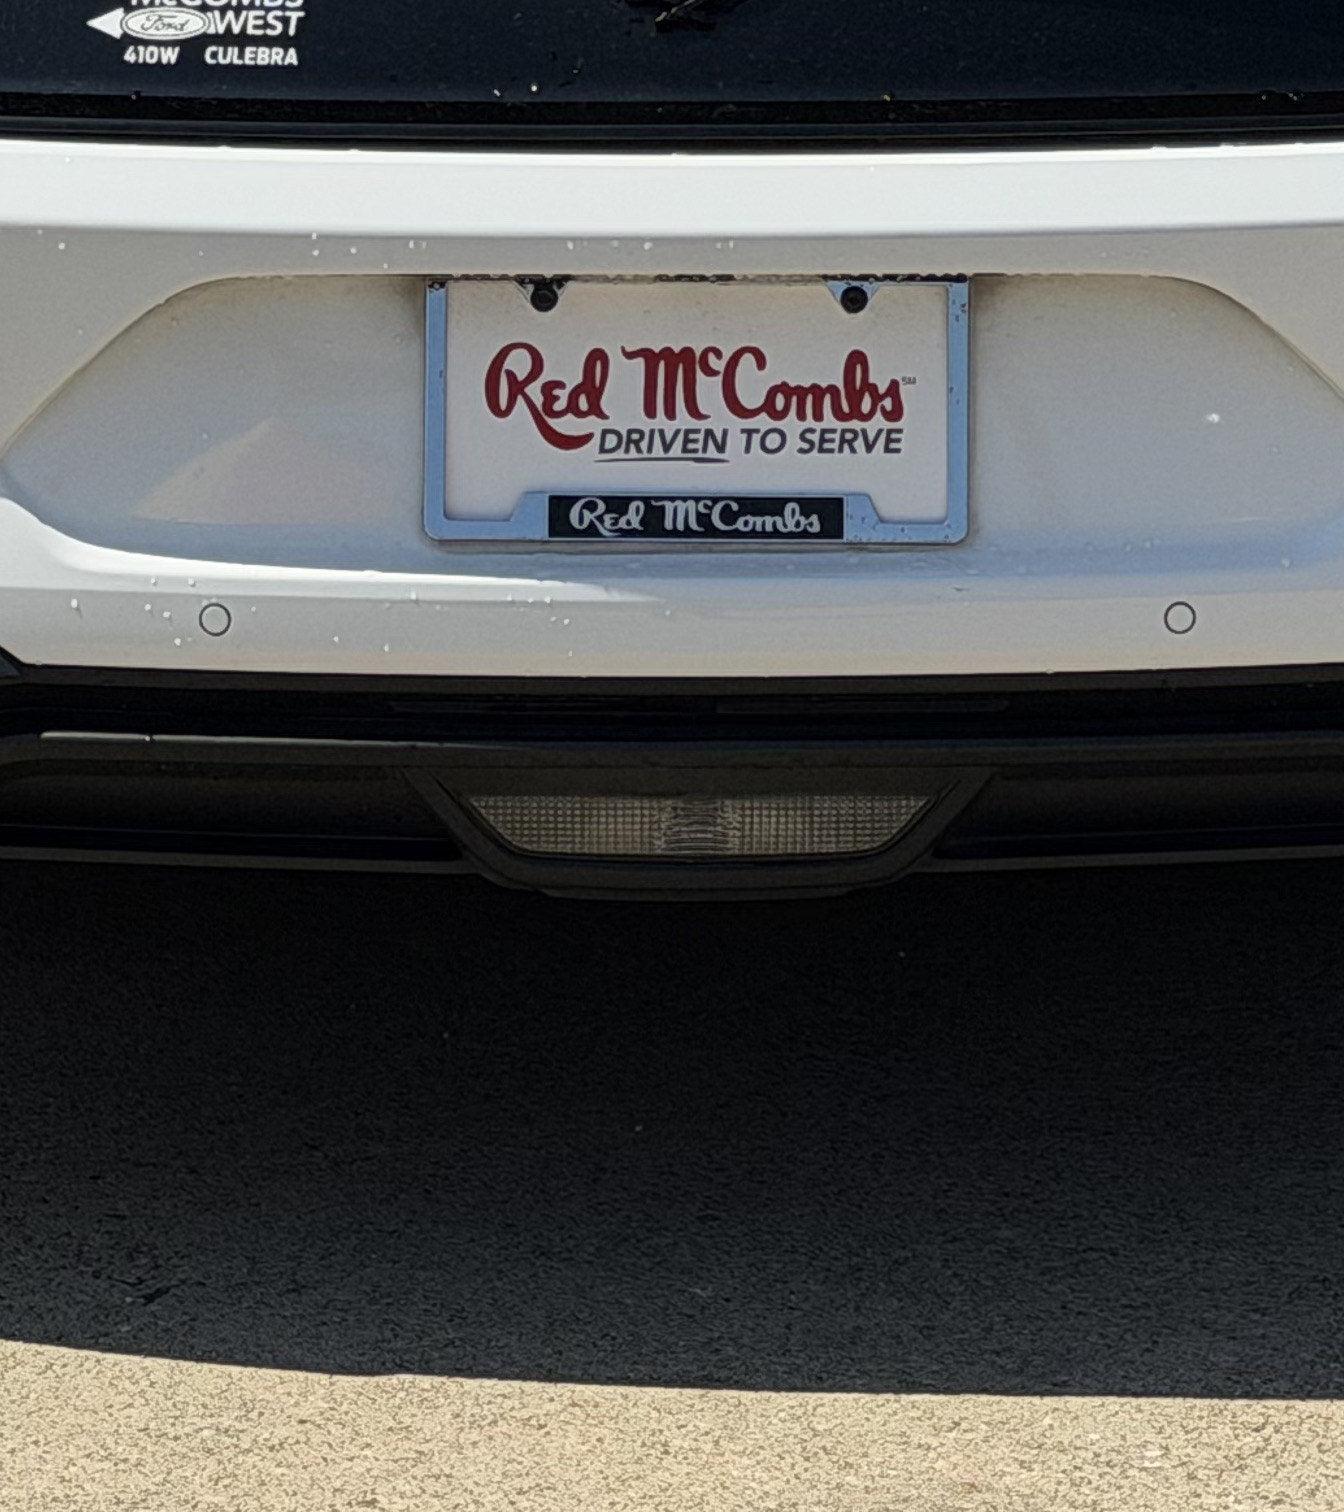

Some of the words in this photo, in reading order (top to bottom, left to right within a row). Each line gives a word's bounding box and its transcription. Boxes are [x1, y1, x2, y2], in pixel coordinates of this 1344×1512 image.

[212, 10, 305, 37] WEST
[123, 45, 180, 64] 410W
[205, 45, 298, 66] CULEBRA
[484, 342, 610, 451] Red
[621, 345, 904, 422] McCombs
[598, 427, 729, 455] DRIVEN
[740, 427, 788, 455] TO
[796, 427, 904, 455] SERVE
[568, 496, 644, 536] Red
[651, 499, 821, 533] McCombs
